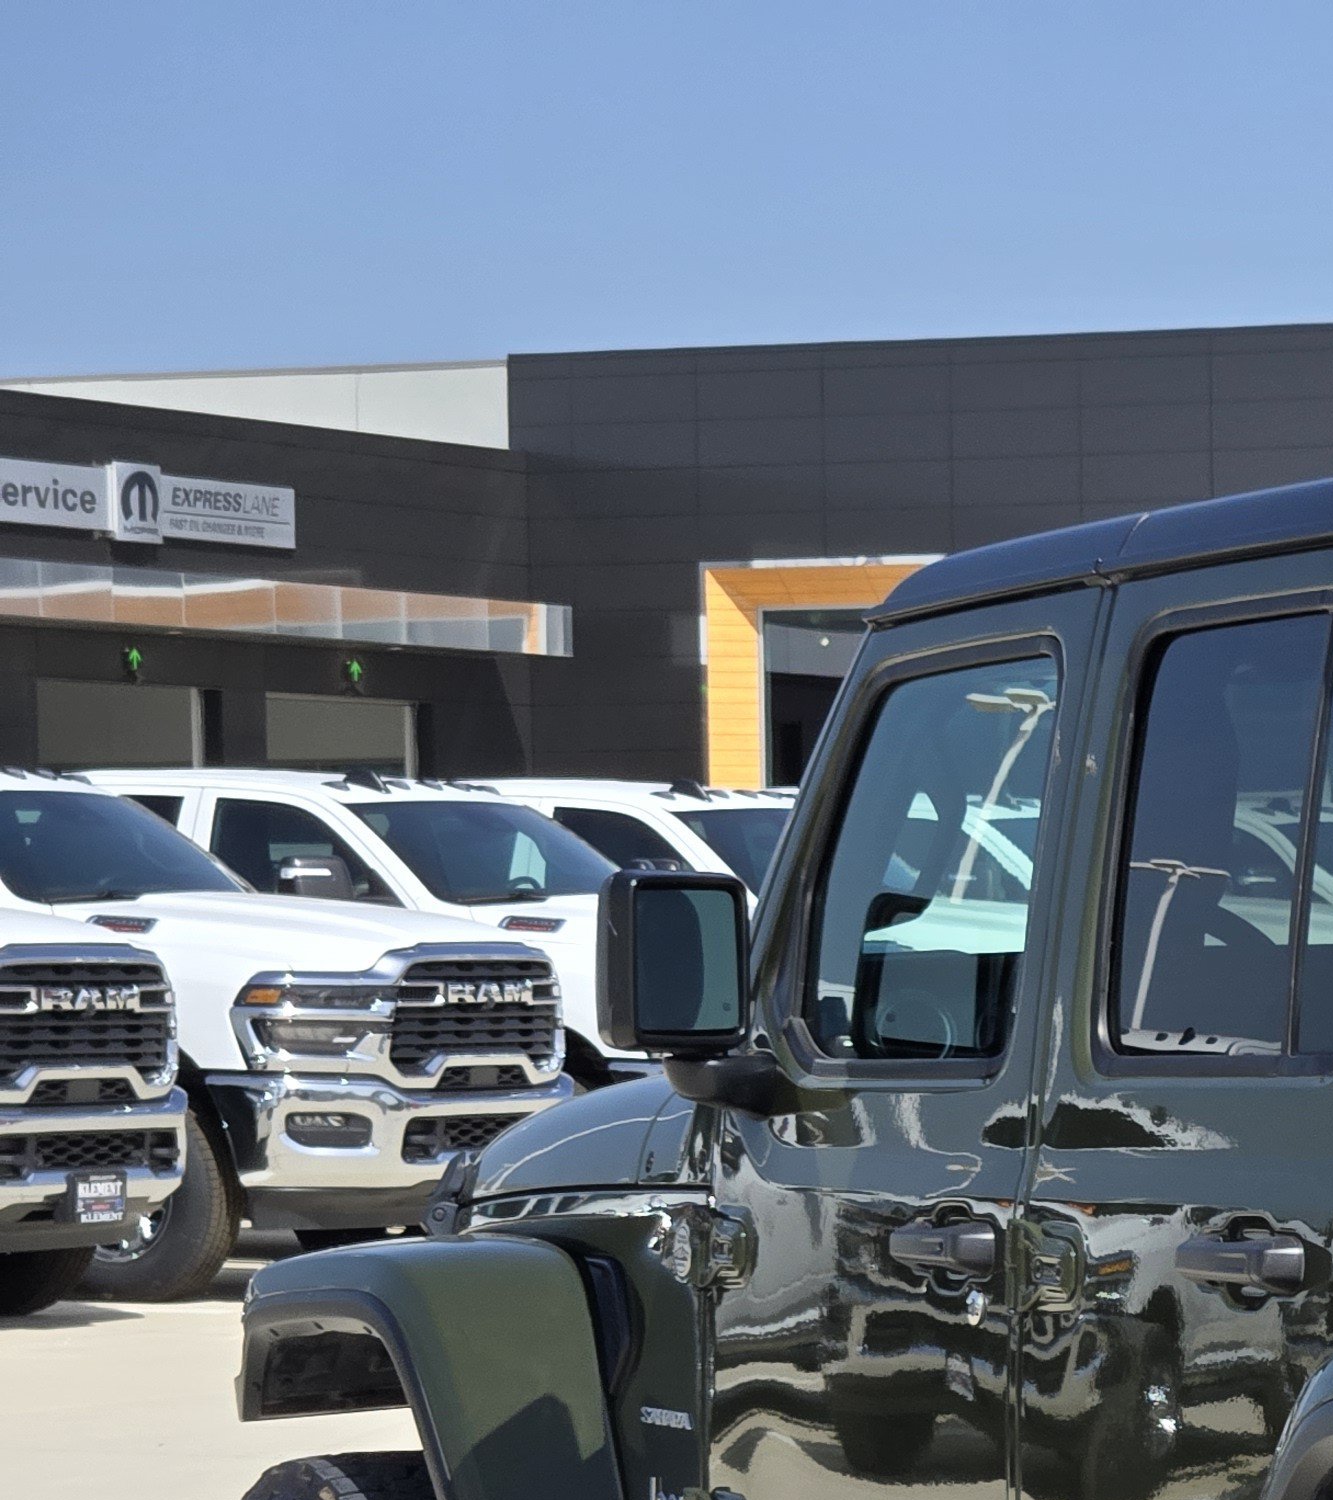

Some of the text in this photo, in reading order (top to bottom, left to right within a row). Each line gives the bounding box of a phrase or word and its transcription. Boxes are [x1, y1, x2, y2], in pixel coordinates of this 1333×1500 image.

[1, 478, 97, 514] ervice
[42, 984, 140, 1012] RAM
[447, 981, 534, 1004] RAM
